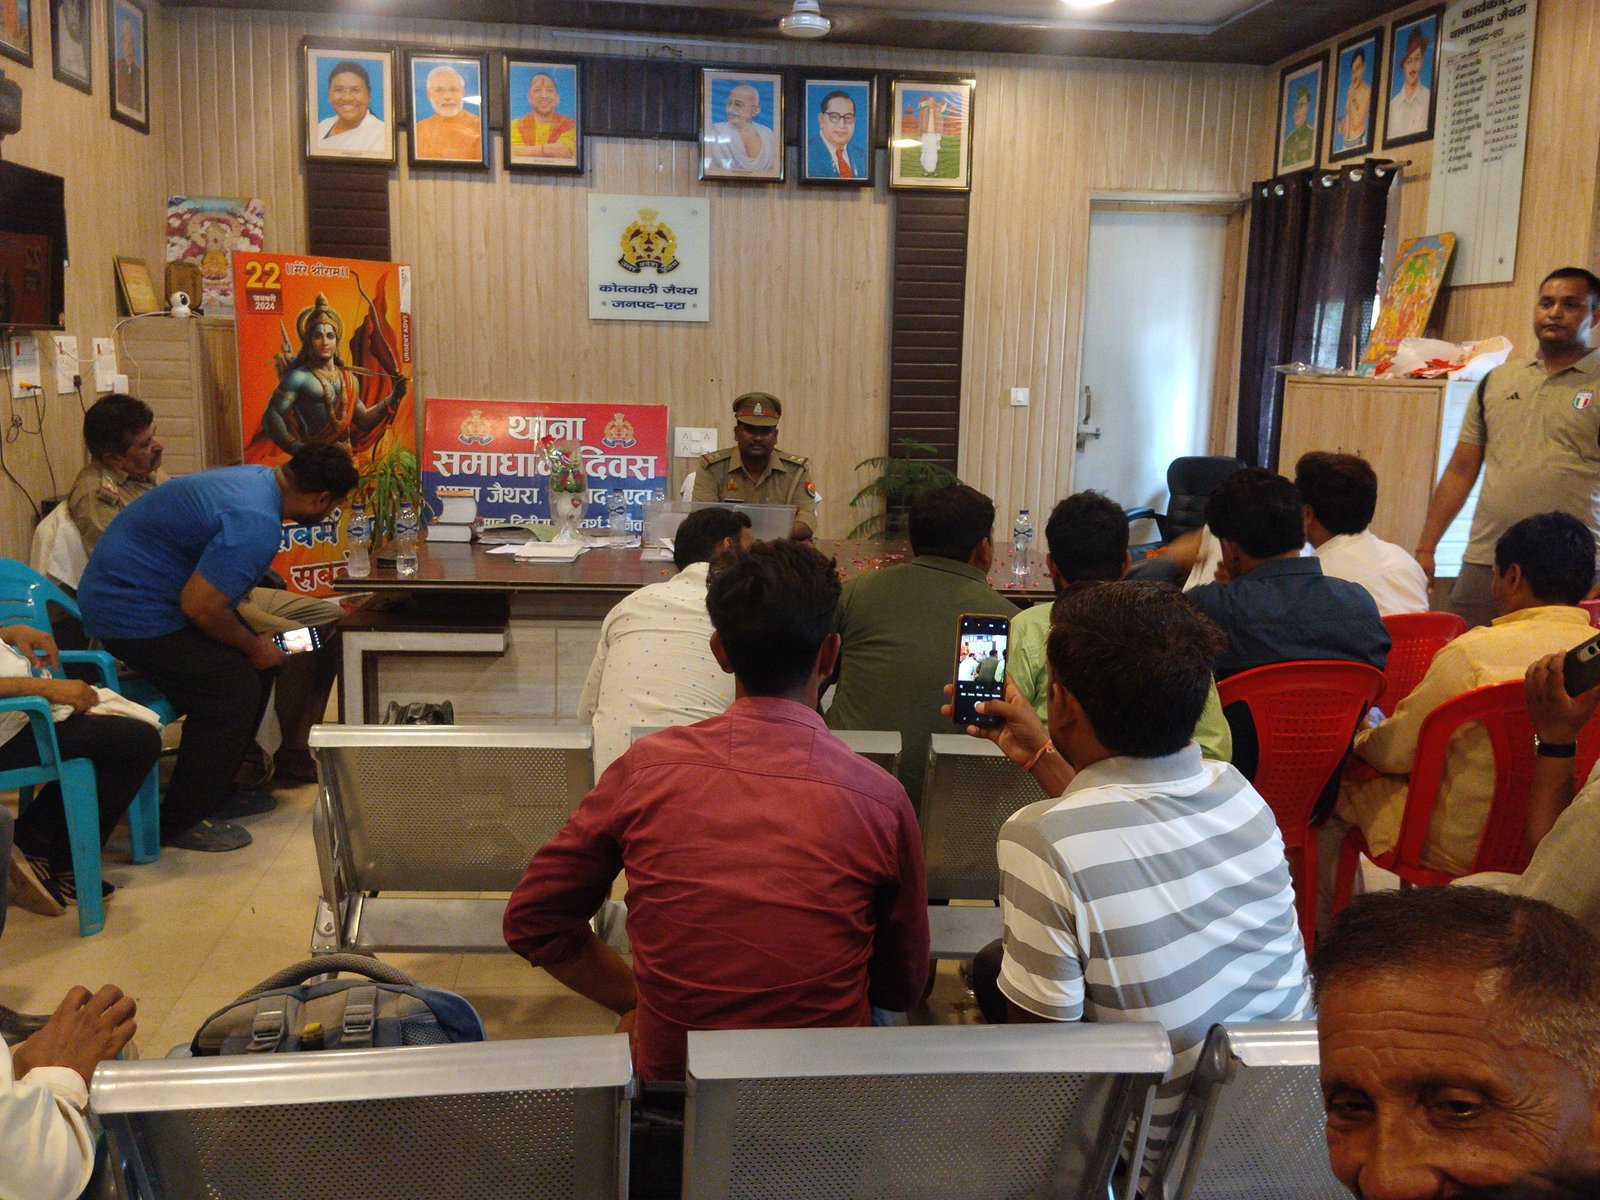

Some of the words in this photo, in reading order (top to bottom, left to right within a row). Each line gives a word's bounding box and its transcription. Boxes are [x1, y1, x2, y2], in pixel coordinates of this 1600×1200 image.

[245, 260, 281, 289] 22
[598, 283, 659, 295] कोतवाली
[662, 284, 699, 295] जैथरा
[255, 301, 275, 311] 2024
[508, 415, 587, 441] थाना
[579, 445, 658, 482] दिवस
